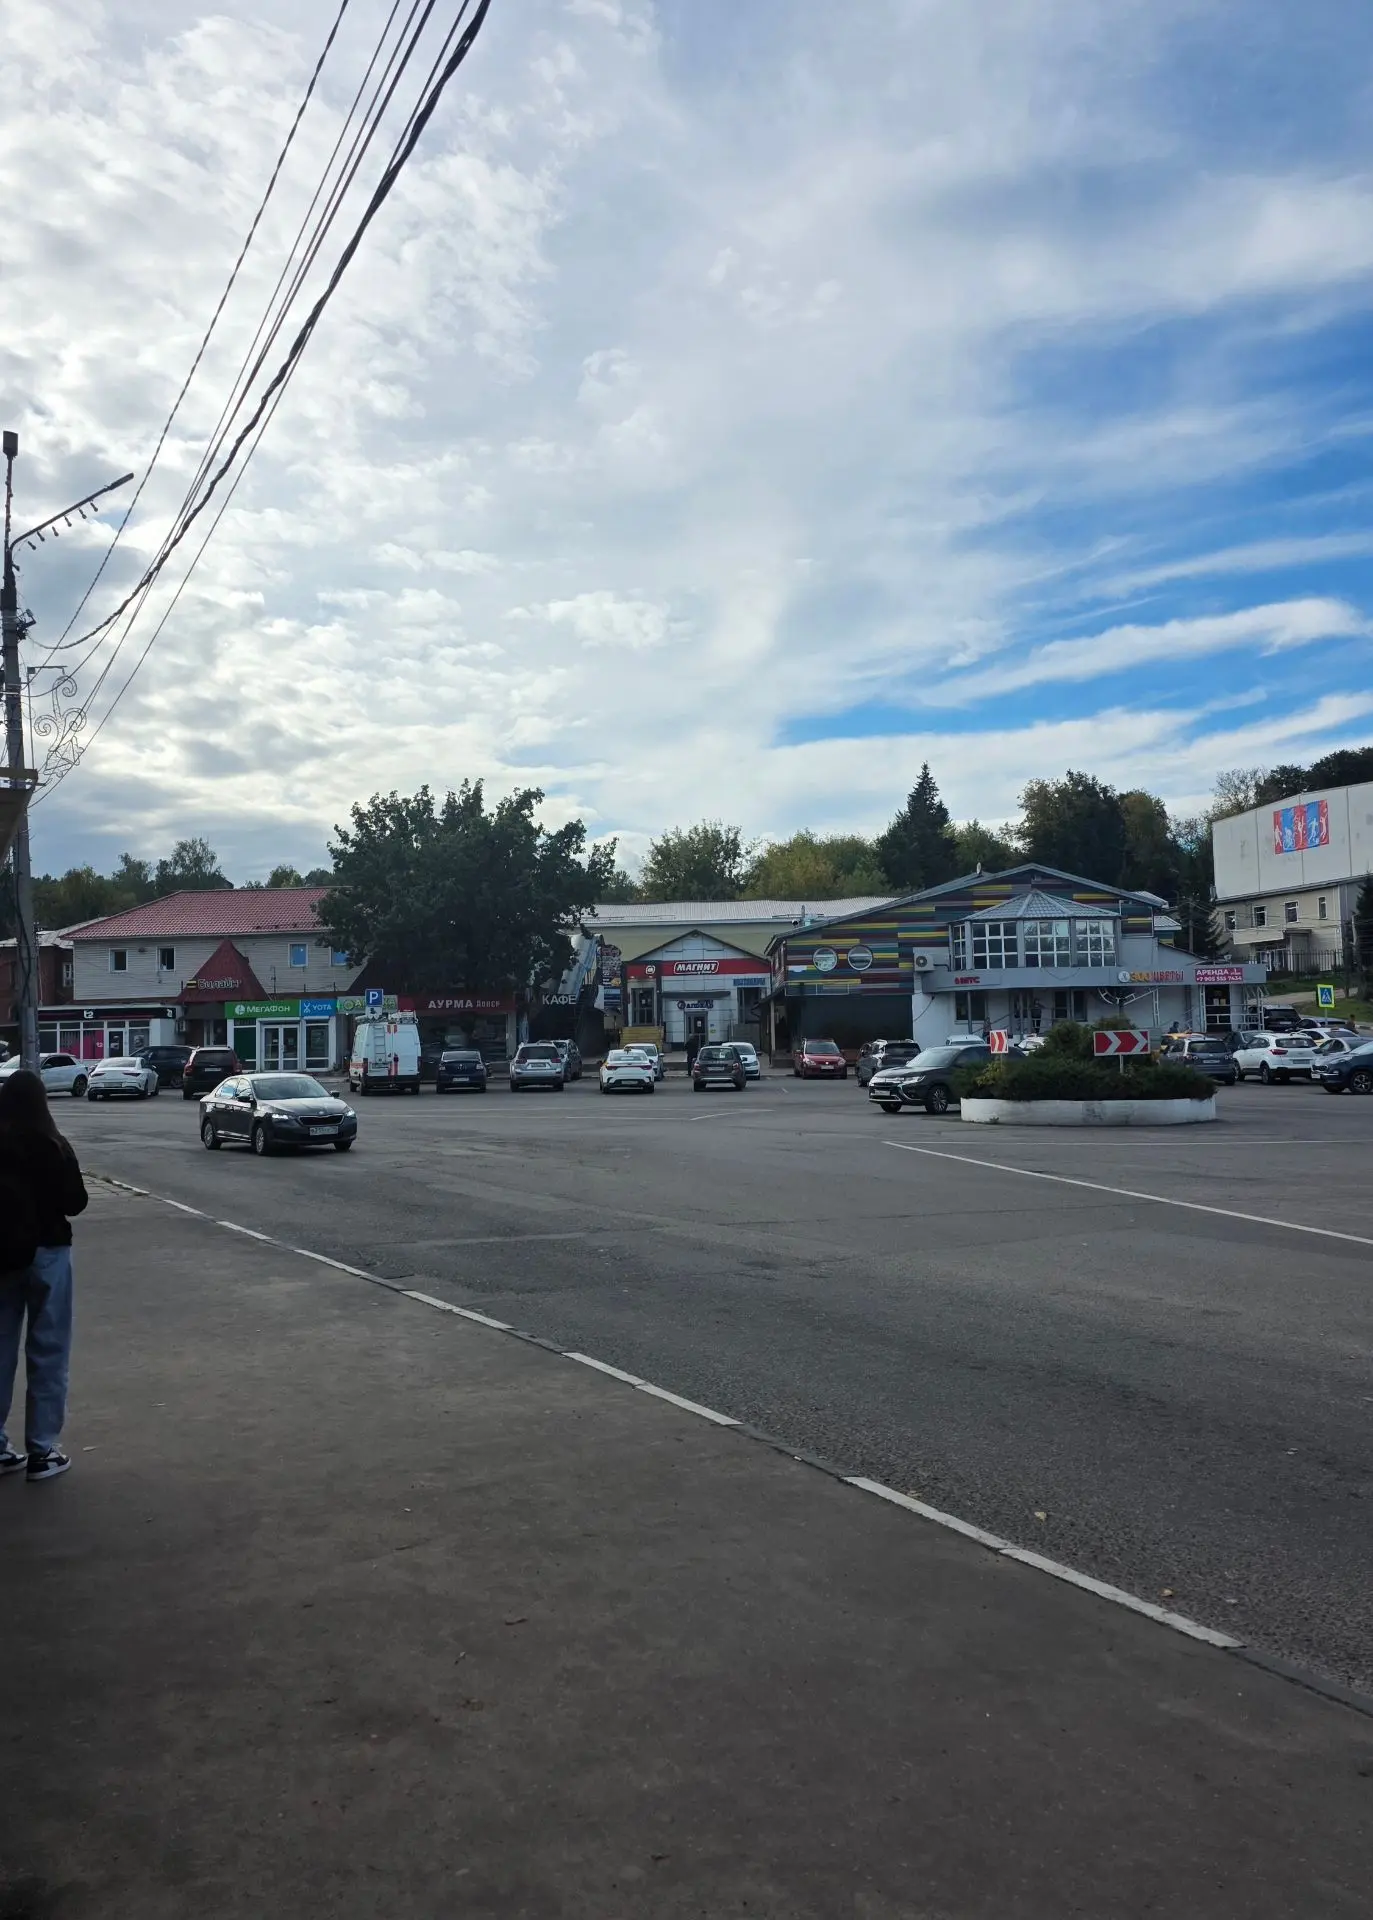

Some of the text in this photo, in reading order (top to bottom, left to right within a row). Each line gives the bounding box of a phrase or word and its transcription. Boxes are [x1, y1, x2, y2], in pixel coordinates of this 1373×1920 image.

[677, 963, 717, 972] МАГНИТ
[369, 991, 379, 1004] P
[542, 994, 577, 1005] КАФЕ
[312, 1003, 332, 1011] YOTA
